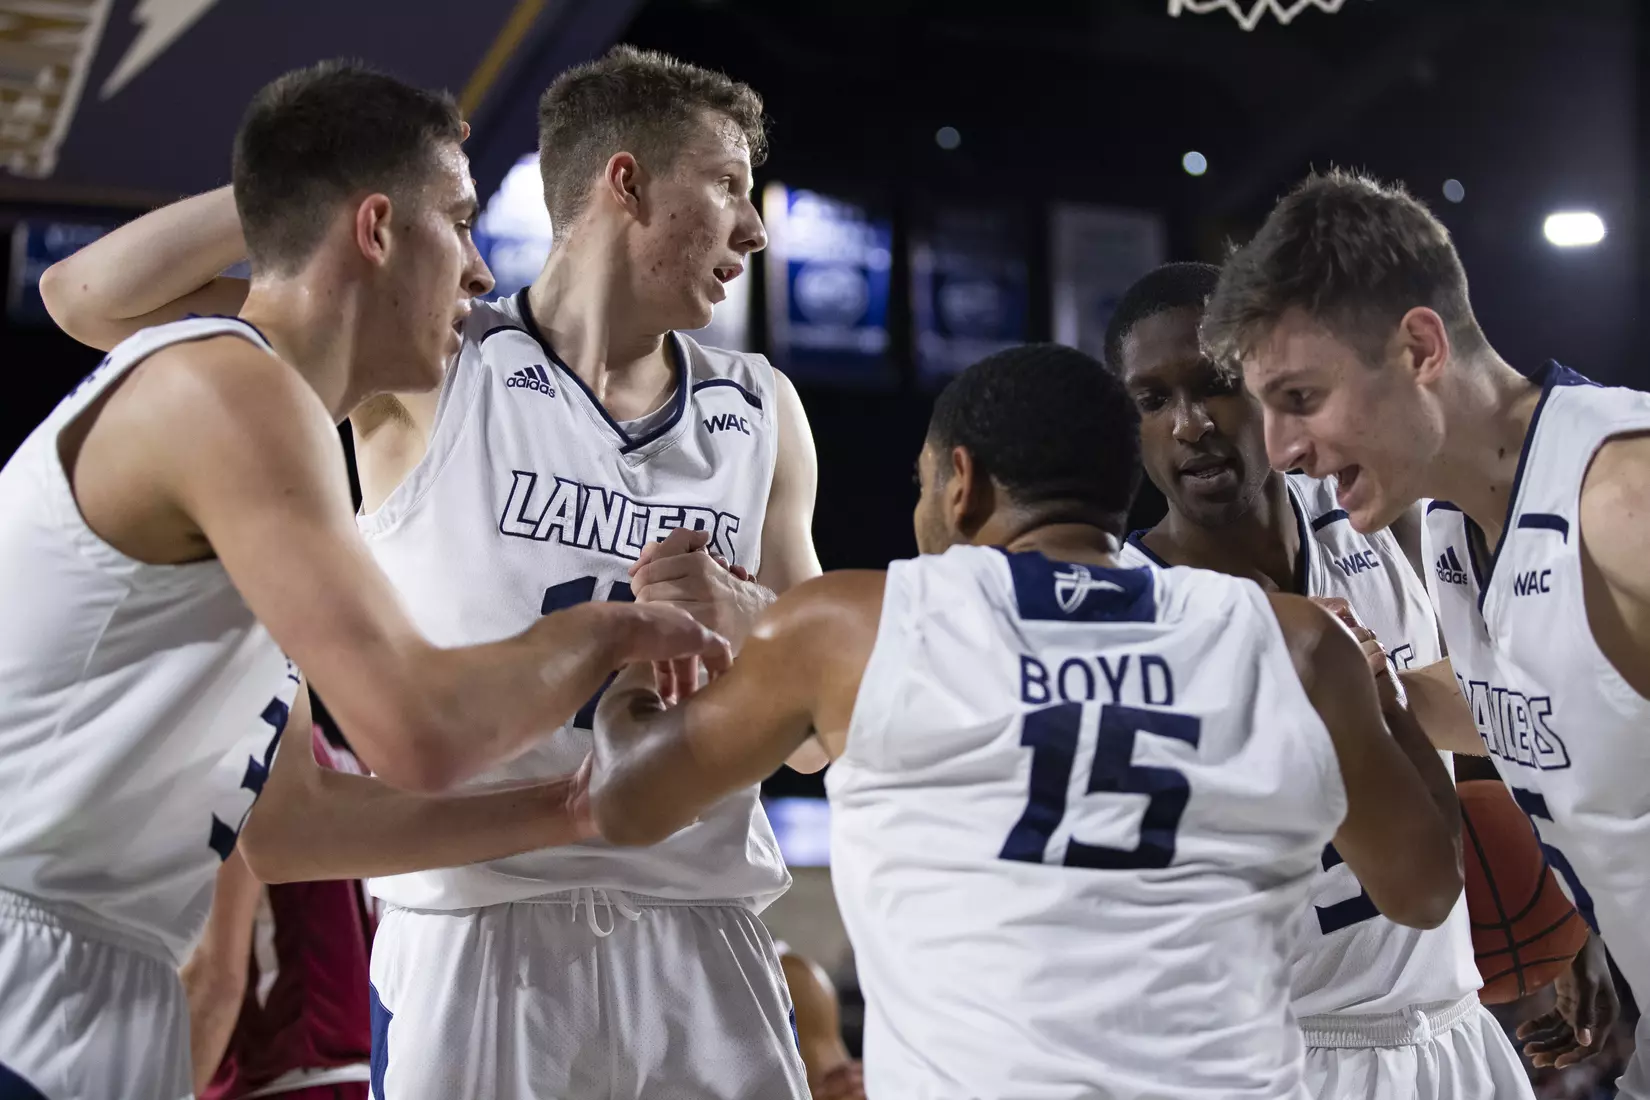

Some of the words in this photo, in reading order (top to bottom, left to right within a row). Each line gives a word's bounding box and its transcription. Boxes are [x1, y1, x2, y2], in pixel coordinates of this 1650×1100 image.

[506, 375, 556, 399] adidas
[703, 413, 750, 436] WAC
[1335, 549, 1380, 577] WAC
[1513, 568, 1552, 597] WAC
[1020, 653, 1175, 706] BOYD
[998, 701, 1201, 869] 15
